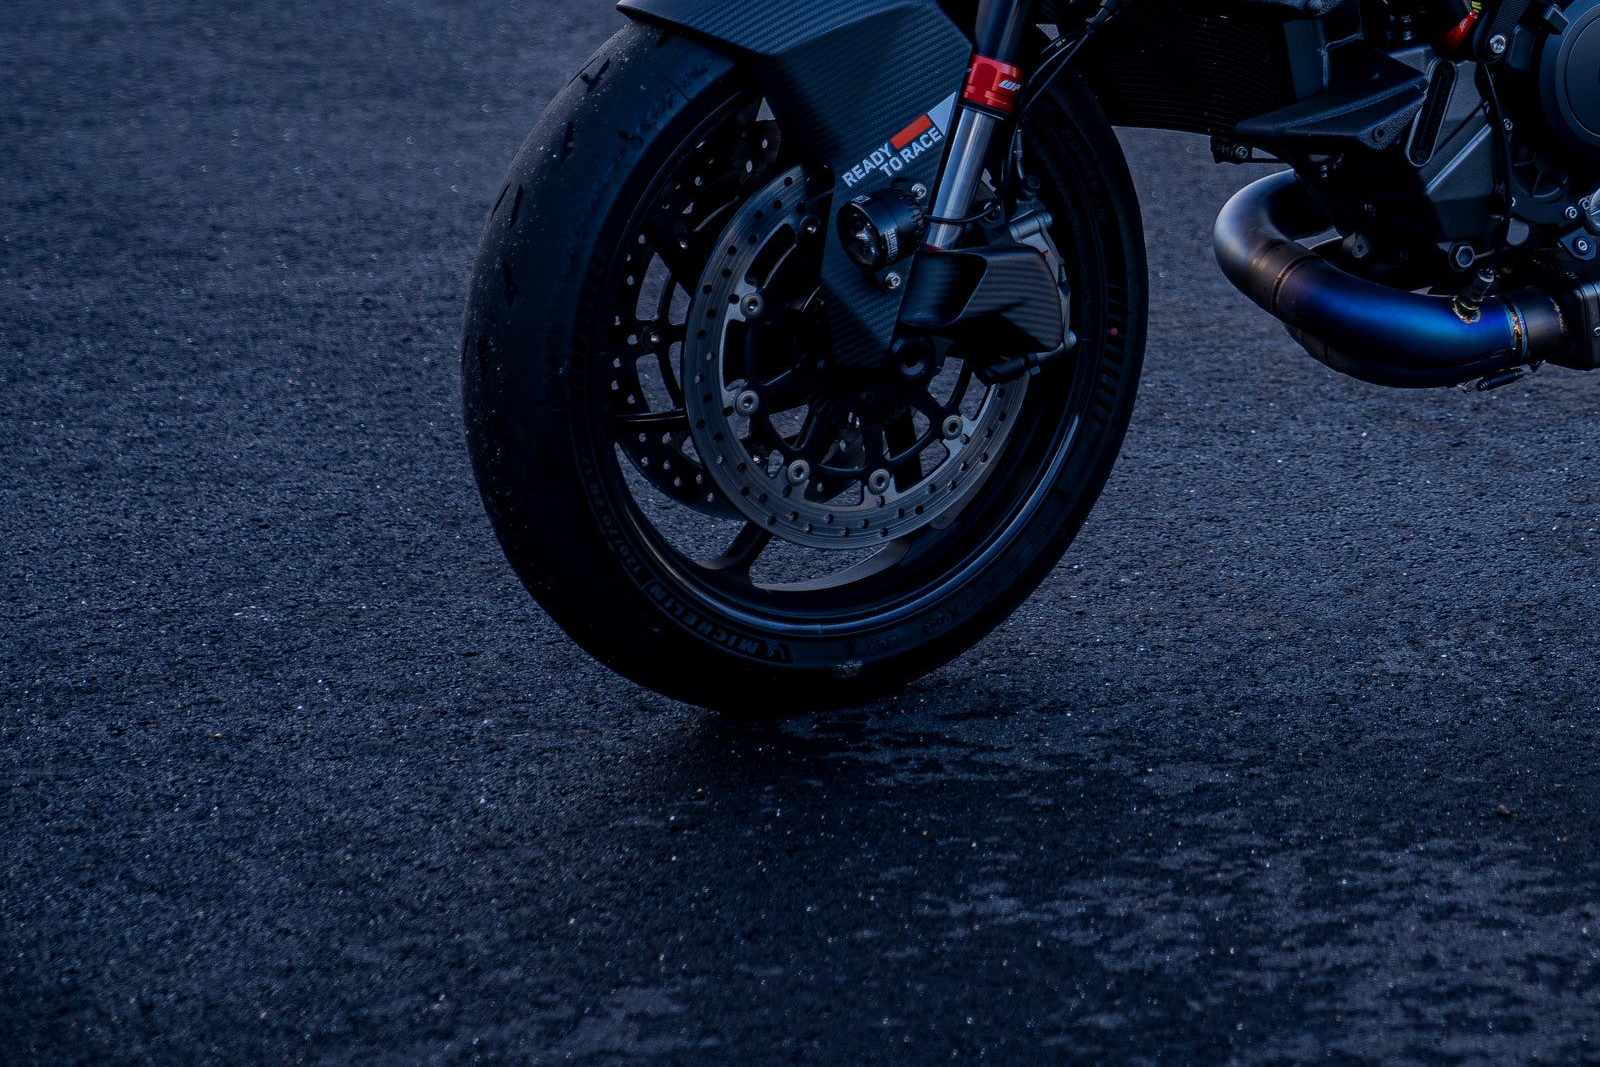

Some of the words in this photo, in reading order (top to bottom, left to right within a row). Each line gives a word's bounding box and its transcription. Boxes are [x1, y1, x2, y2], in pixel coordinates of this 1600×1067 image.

[998, 79, 1022, 92] WP
[841, 142, 893, 187] READY
[879, 155, 903, 178] TO
[900, 126, 944, 163] RACE
[649, 584, 760, 655] MICHELIN
